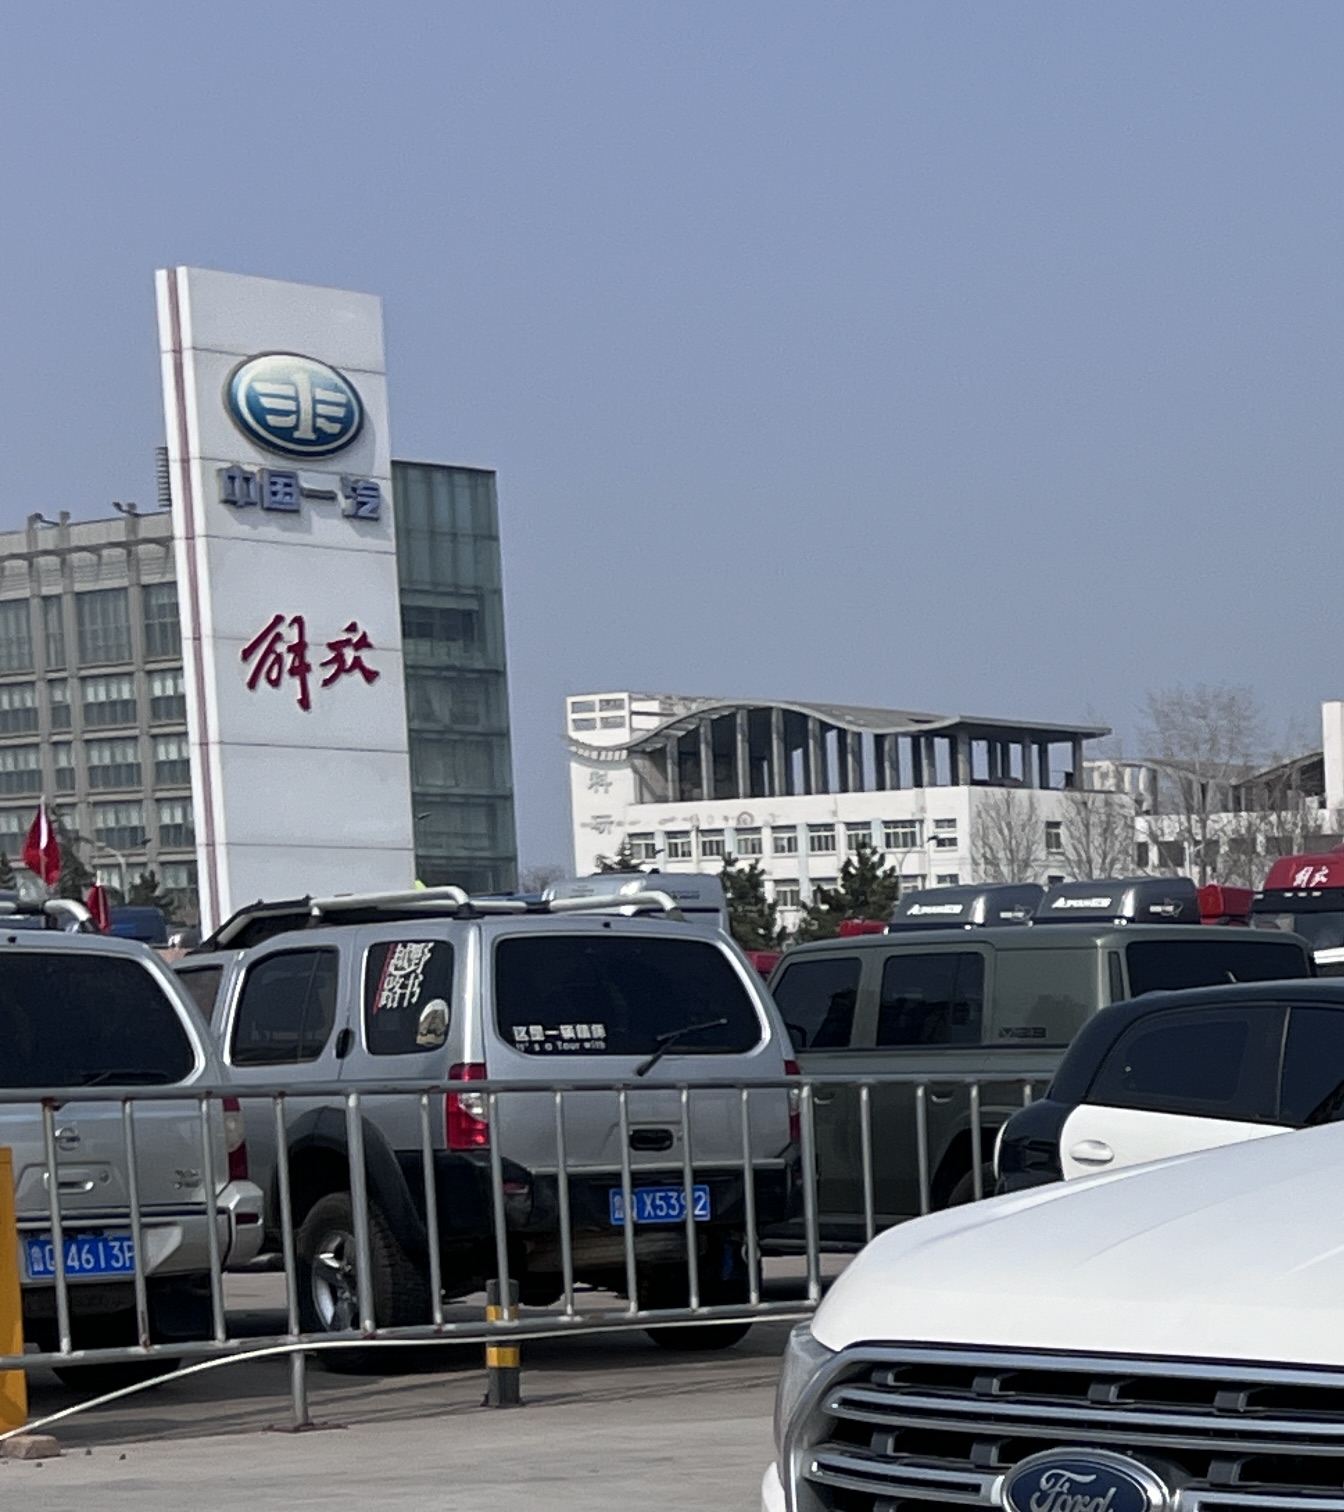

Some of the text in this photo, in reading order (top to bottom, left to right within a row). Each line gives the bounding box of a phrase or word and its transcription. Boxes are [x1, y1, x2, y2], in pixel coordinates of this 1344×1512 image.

[217, 464, 381, 521] 中国一汽
[240, 613, 381, 713] 解放
